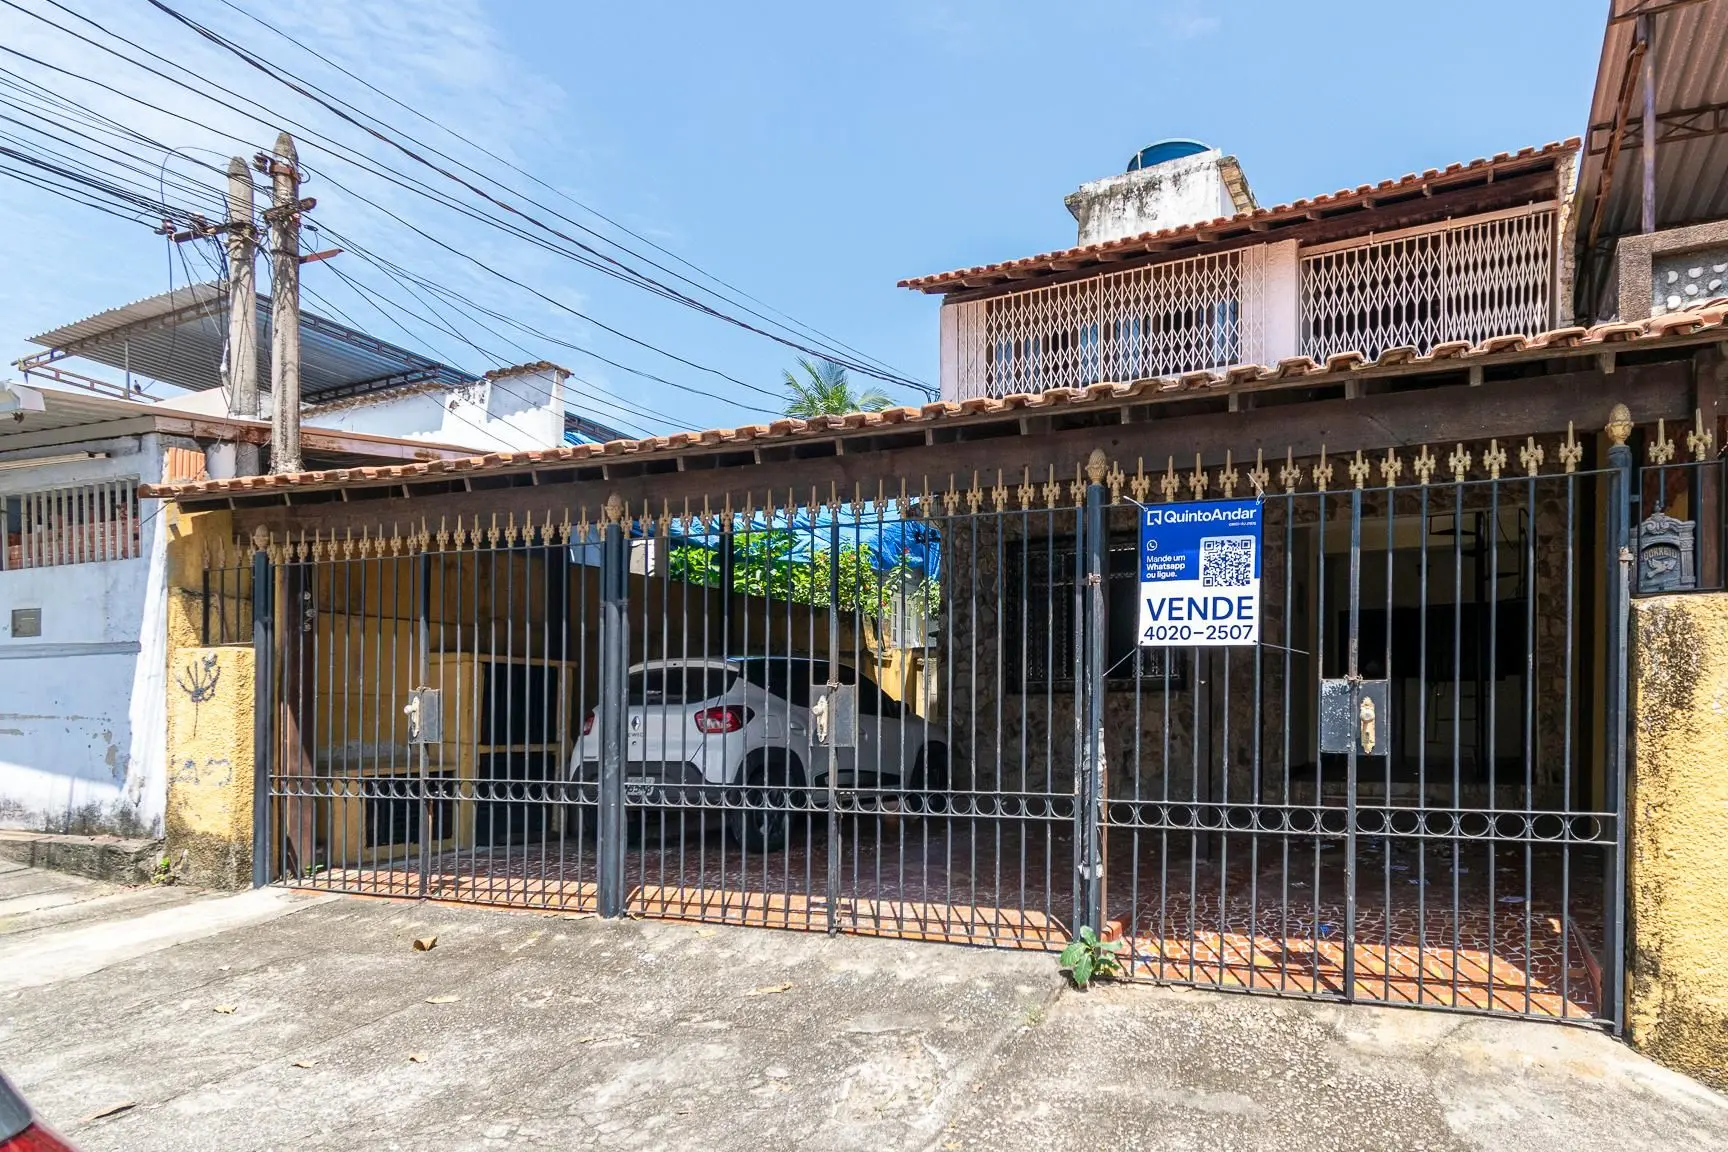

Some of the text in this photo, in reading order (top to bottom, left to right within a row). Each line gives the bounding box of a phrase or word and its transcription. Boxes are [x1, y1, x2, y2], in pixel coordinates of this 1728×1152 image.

[1164, 508, 1256, 523] QuintoAndar
[1146, 563, 1185, 571] Whatsapp
[1146, 596, 1253, 621] VENDE
[1144, 625, 1253, 640] 4020-2507
